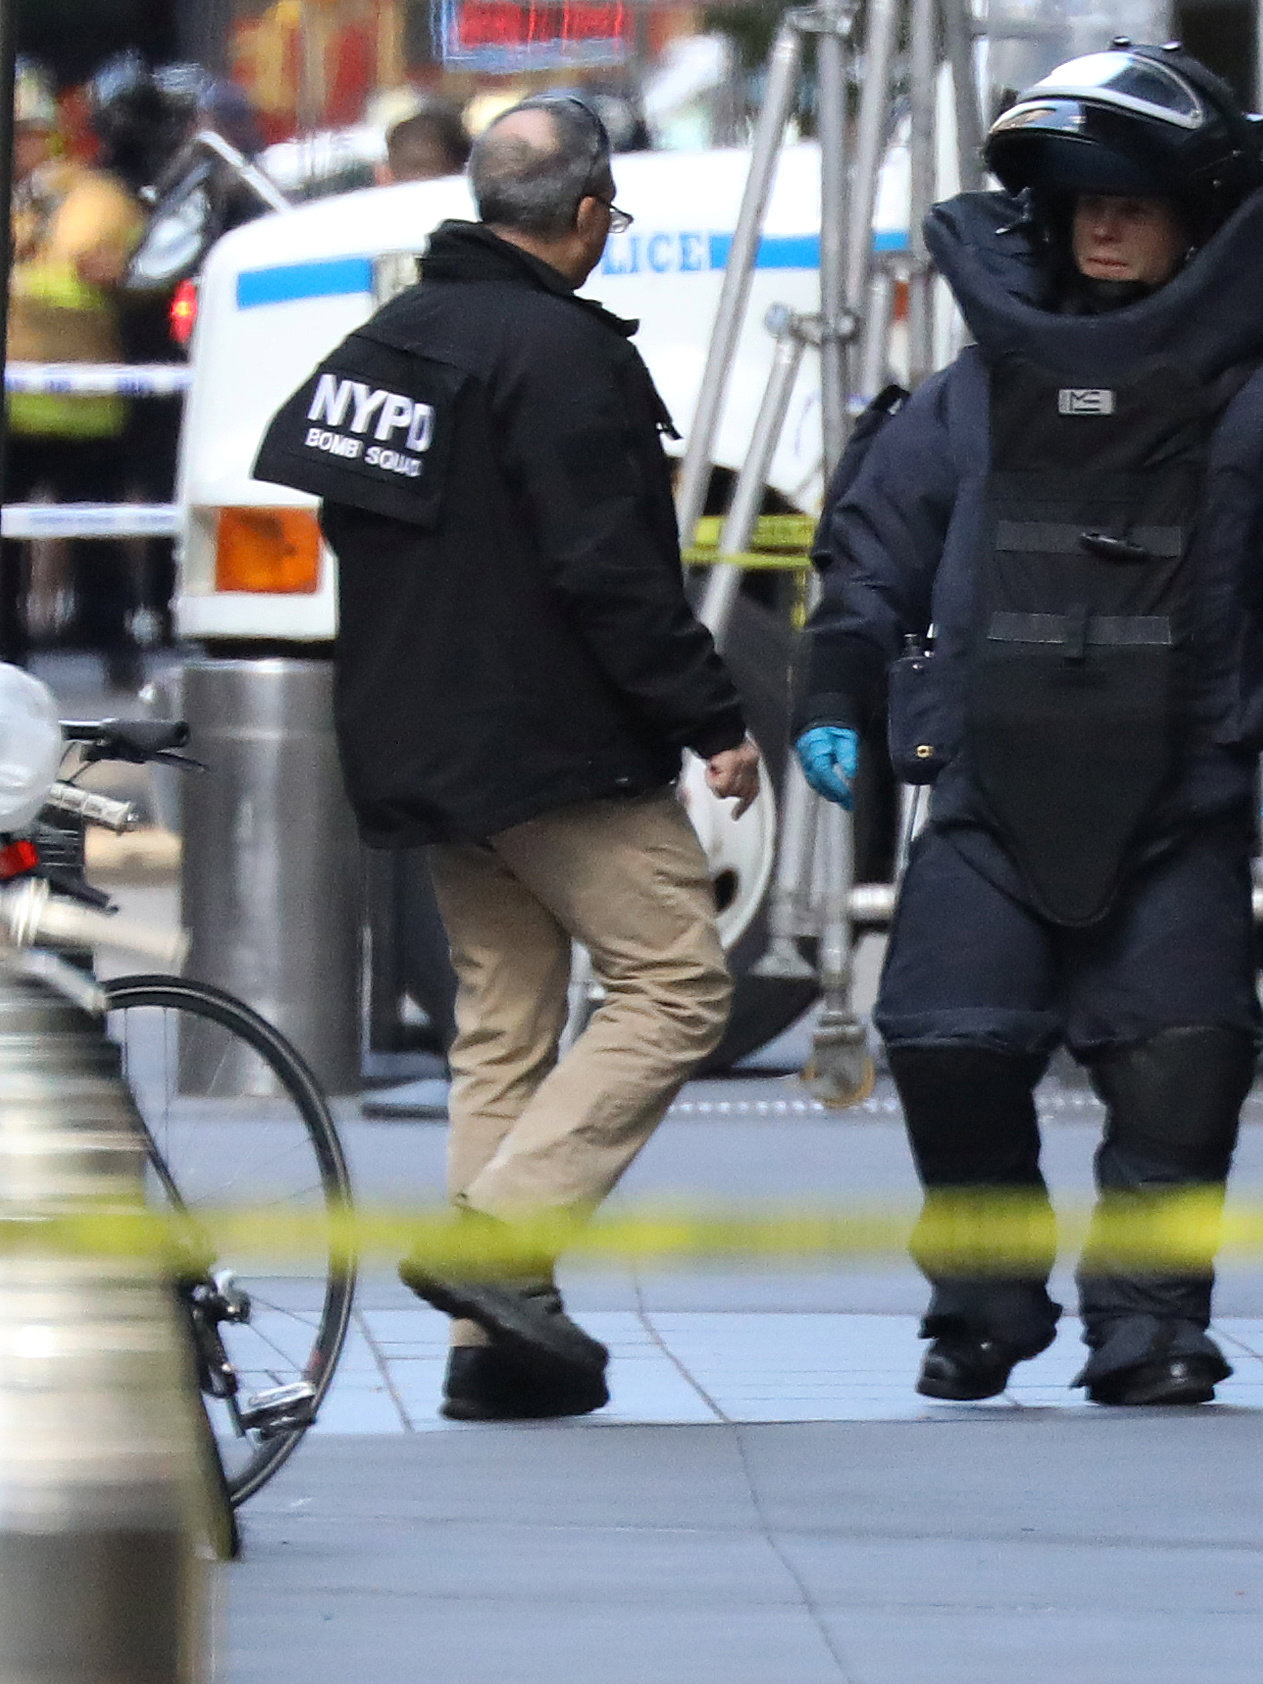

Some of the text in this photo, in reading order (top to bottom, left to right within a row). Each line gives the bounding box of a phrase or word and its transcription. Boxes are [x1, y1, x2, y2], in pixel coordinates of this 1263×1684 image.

[602, 233, 702, 274] LICE
[306, 373, 436, 453] NYPD
[303, 427, 424, 478] BOMB SQUAD
